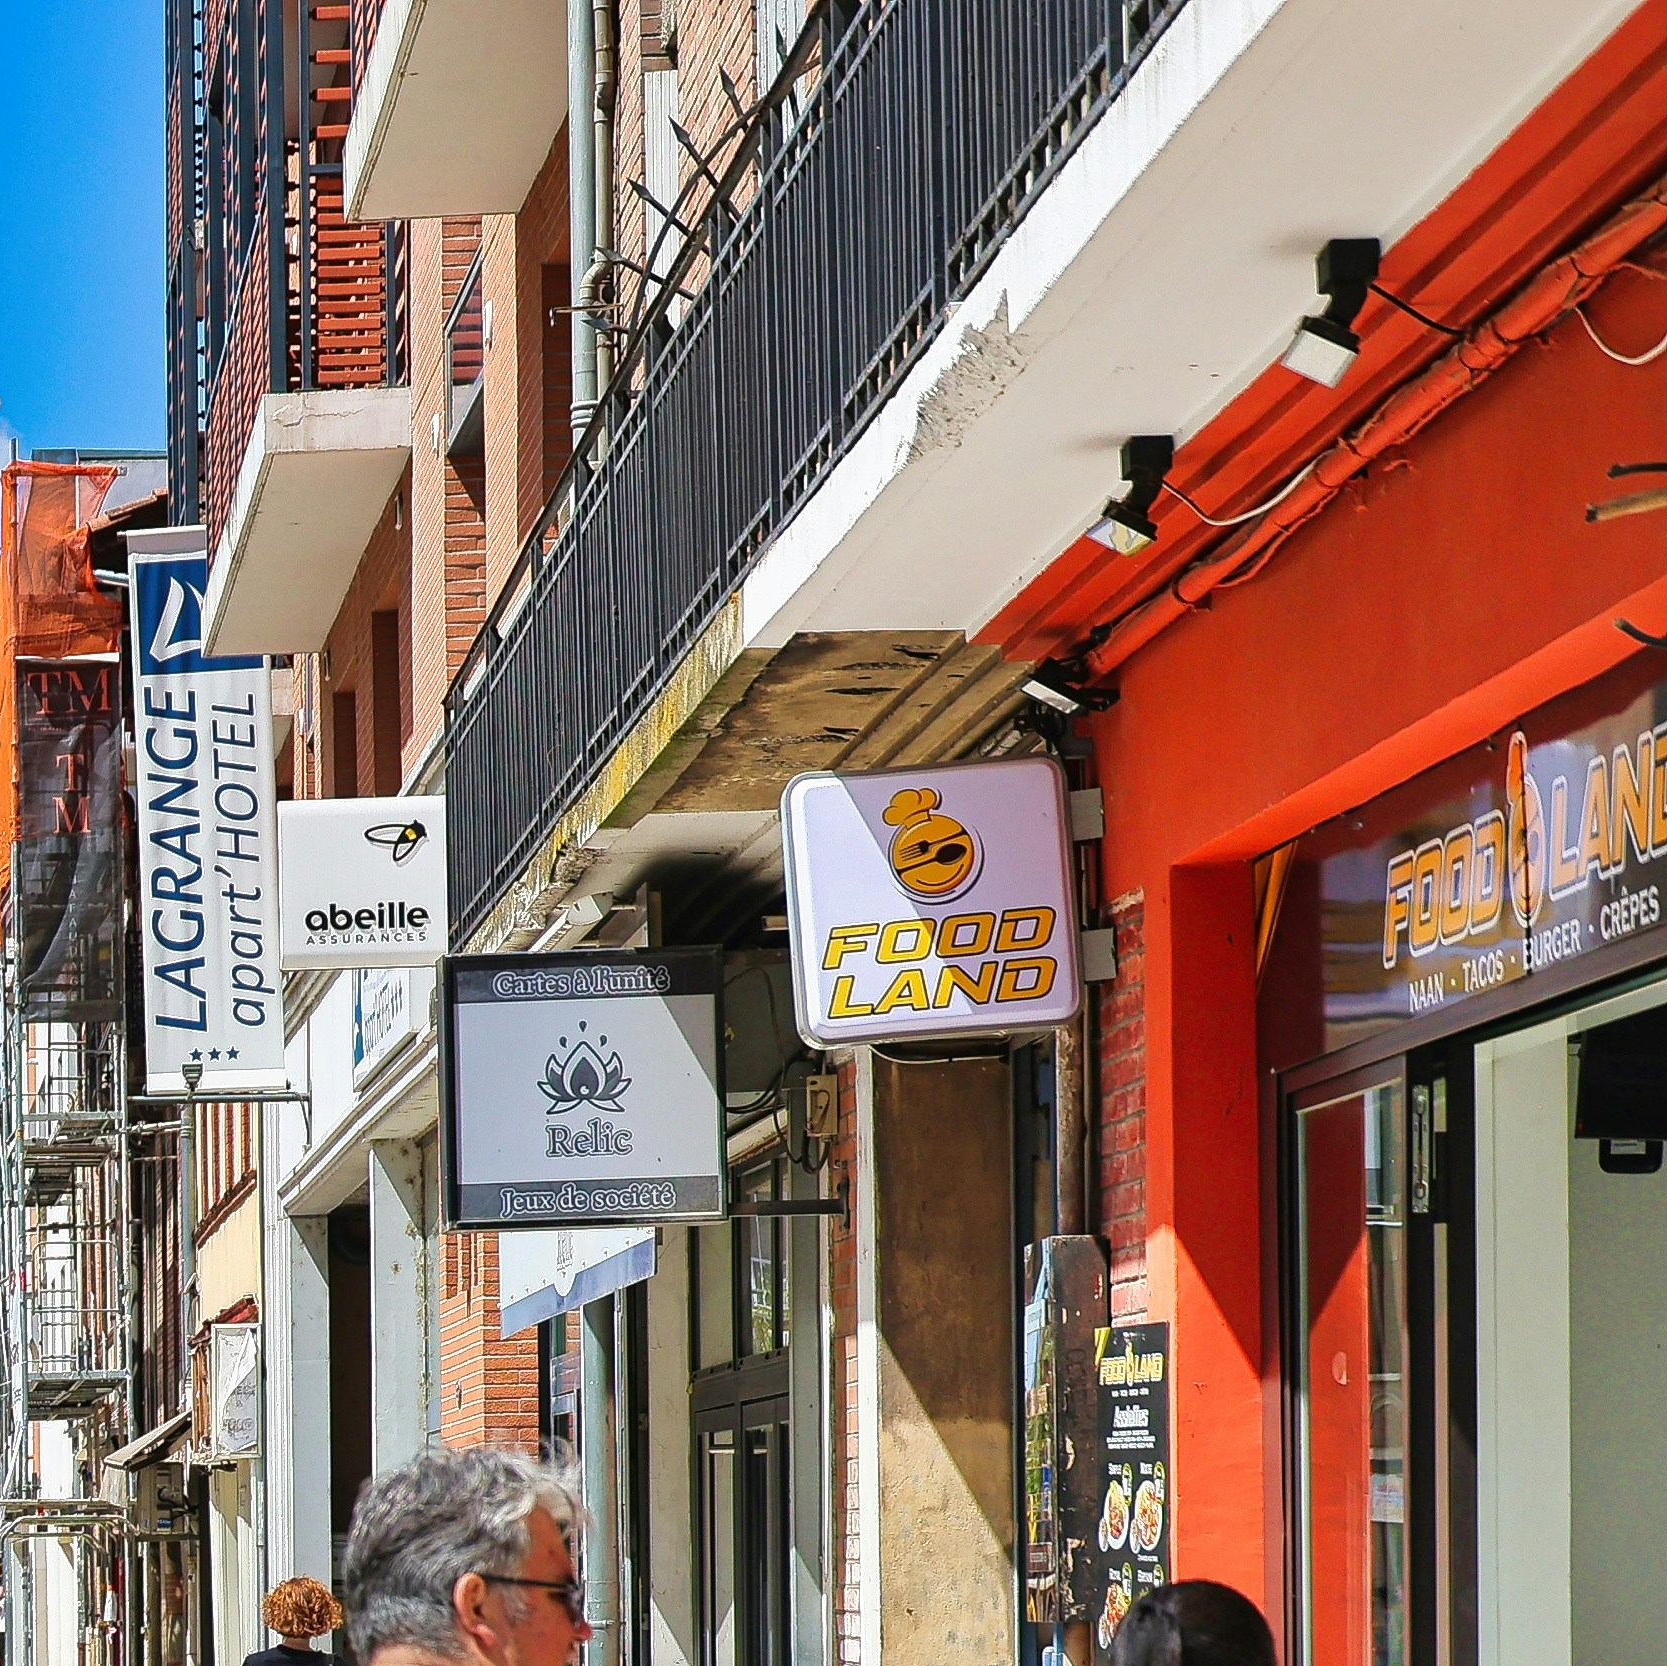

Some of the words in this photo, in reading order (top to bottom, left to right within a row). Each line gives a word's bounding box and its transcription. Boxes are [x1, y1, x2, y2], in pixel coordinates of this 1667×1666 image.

[27, 668, 111, 714] TM
[144, 686, 208, 1032] LAGRANGE
[211, 693, 275, 1026] apart'HOTEL
[1382, 808, 1505, 969] FOOD
[305, 902, 430, 931] abeille
[306, 932, 427, 945] ASSURANCES
[822, 906, 1057, 970] FOOD
[1409, 972, 1444, 1012] NAAN
[1461, 949, 1505, 992] TACOS
[1522, 918, 1582, 970] BURGER
[1599, 885, 1660, 941] CRÊPES
[495, 972, 571, 996] Cartes
[575, 969, 590, 993] à
[592, 966, 669, 991] l'unité
[827, 956, 1058, 1019] LAND
[546, 1118, 633, 1157] Relic
[500, 1187, 557, 1218] Jeux
[556, 1183, 589, 1212] de
[592, 1181, 677, 1211] société
